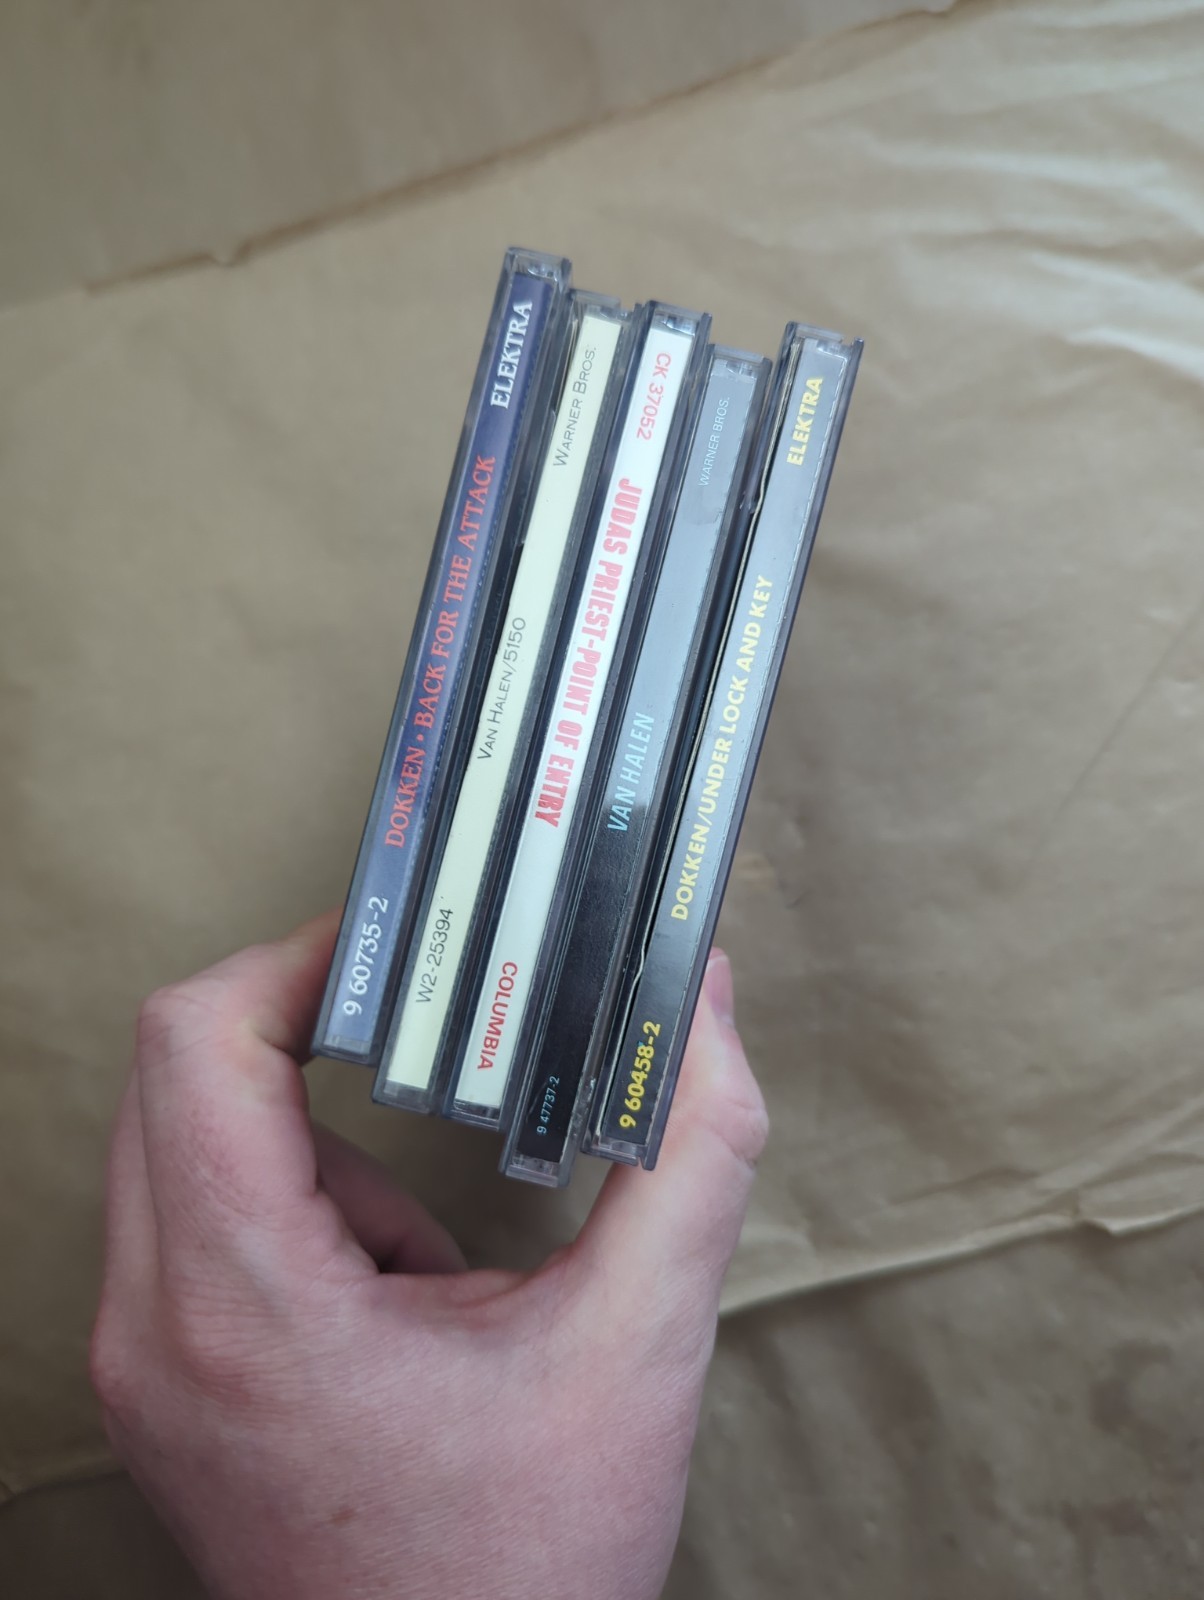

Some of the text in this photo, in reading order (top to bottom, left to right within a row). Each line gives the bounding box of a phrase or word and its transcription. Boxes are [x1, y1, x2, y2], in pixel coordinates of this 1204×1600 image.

[490, 301, 533, 409] ELEKTRA
[553, 347, 597, 467] WARNER BROS.
[637, 352, 671, 440] CK 37052
[698, 396, 730, 487] WARNER BROS.
[787, 376, 824, 466] ELEKTRA
[384, 453, 497, 848] DOKKEN BACK FOR THE ATTACK
[477, 617, 527, 760] VAN HALEN/5150
[534, 478, 643, 828] JUDAS PRIEST-POINT OF ENTRY
[607, 712, 655, 833] VAN HALEN
[671, 575, 773, 921] DOKKEN/UNDER LOCK AND KEY
[343, 896, 388, 1017] 9 60735-2
[416, 907, 453, 1005] W2-25394
[477, 961, 518, 1070] COLUMBIA
[536, 1075, 560, 1135] 9 47737-2
[620, 1021, 661, 1129] 9 60458-2
